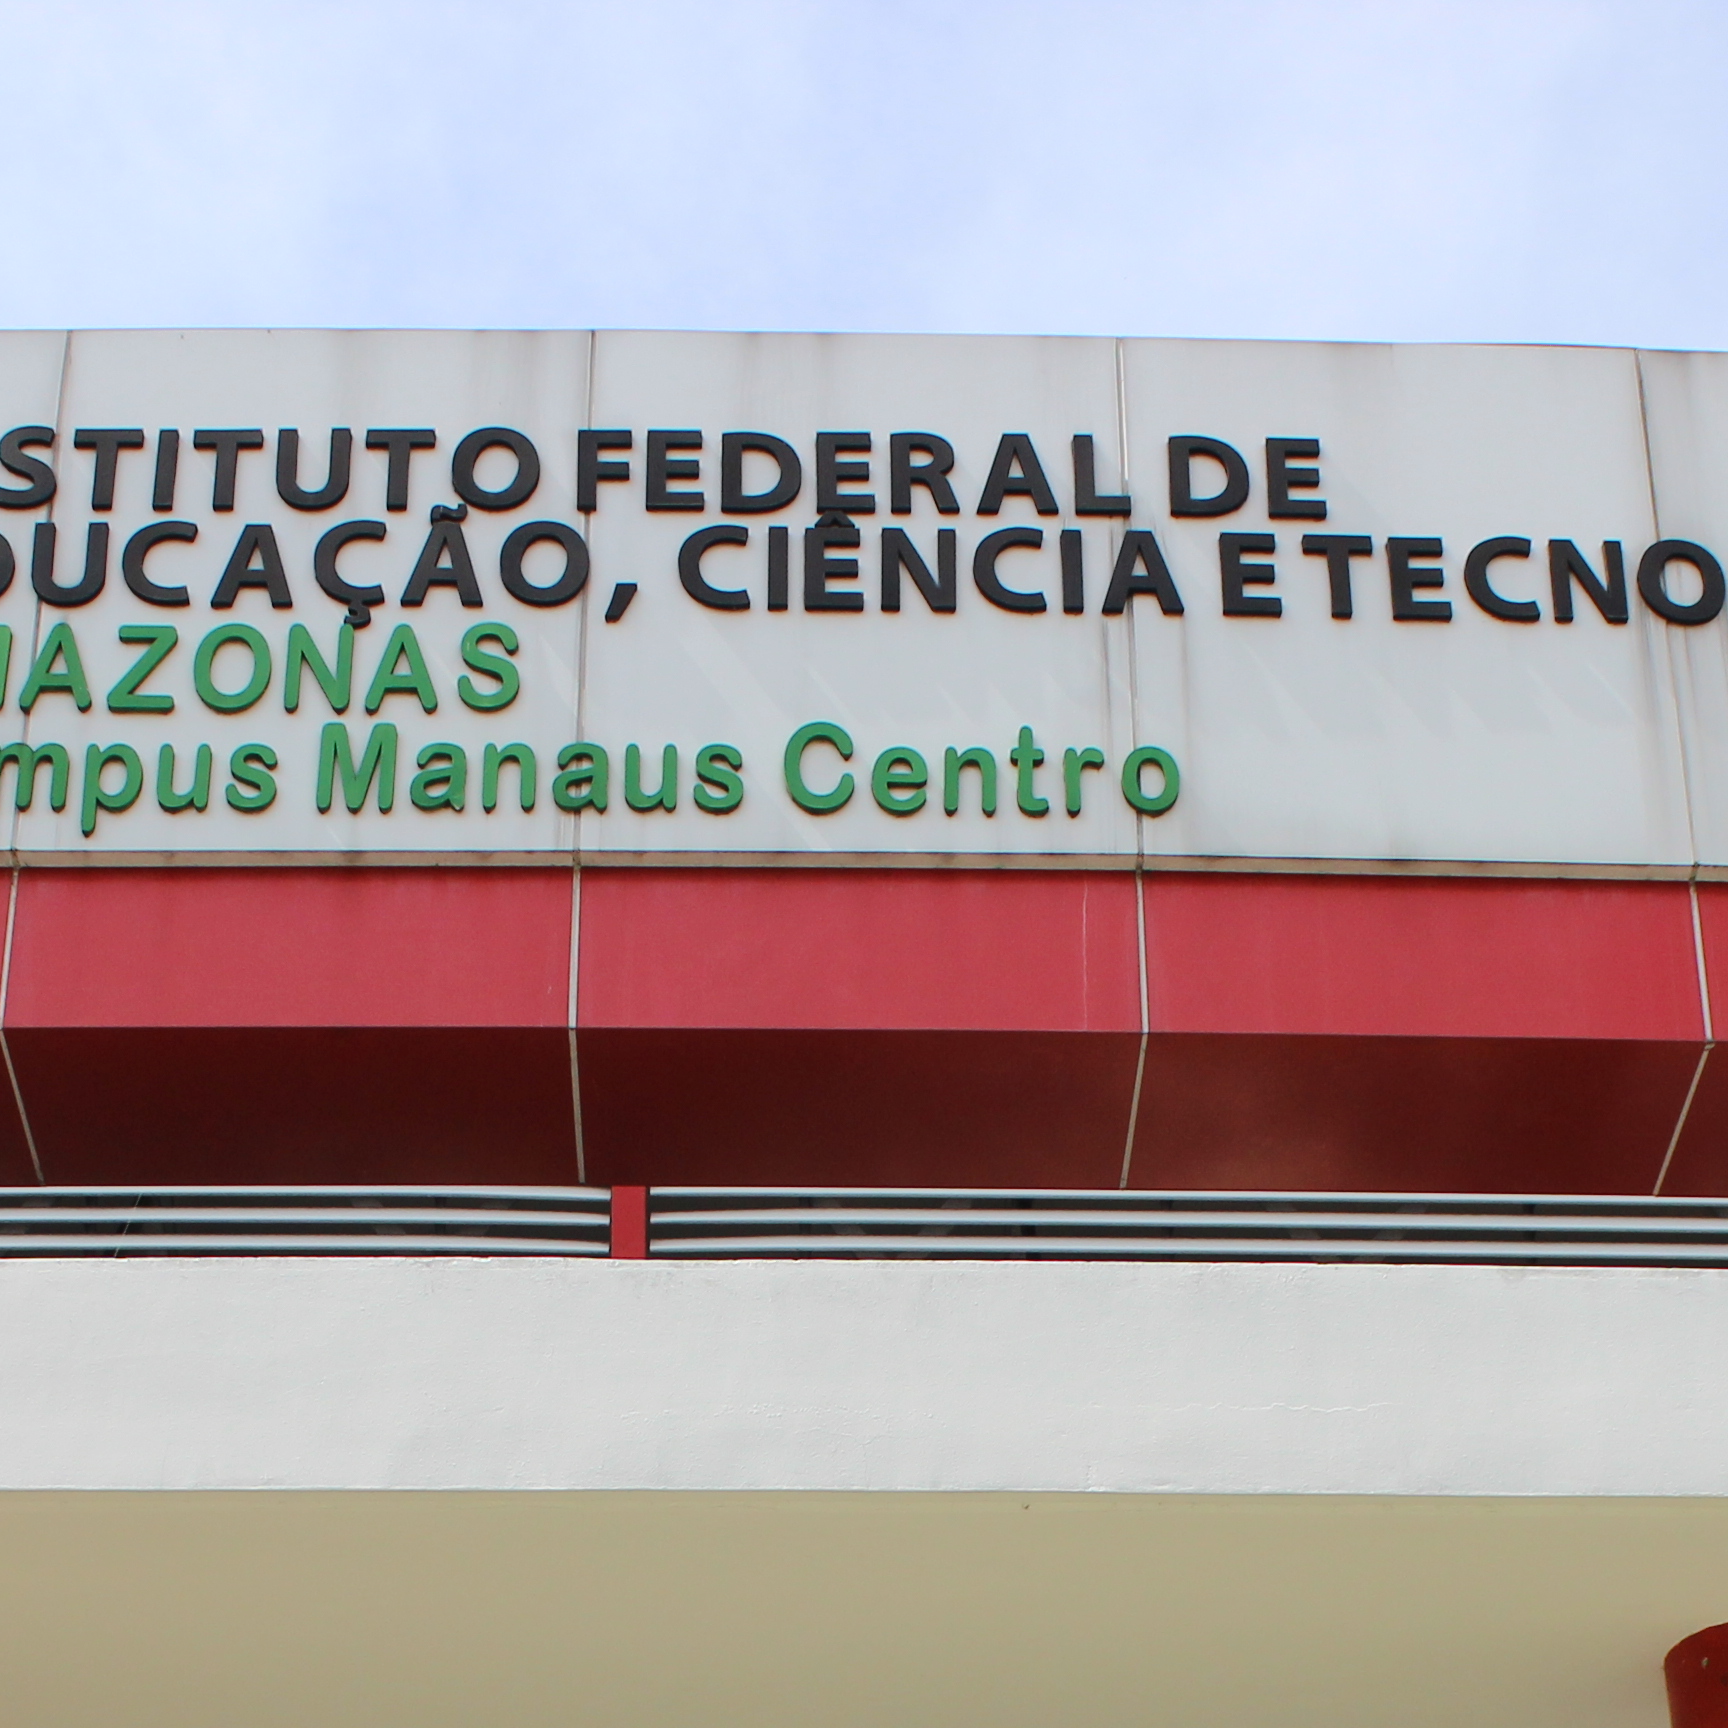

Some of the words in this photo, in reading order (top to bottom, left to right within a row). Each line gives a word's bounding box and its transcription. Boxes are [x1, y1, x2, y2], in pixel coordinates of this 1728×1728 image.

[576, 429, 1134, 520] FEDERAL
[1167, 435, 1329, 522] DE
[676, 510, 1187, 617] CIÊNCIA
[313, 718, 746, 814] Manaus
[780, 717, 1184, 814] Centro
